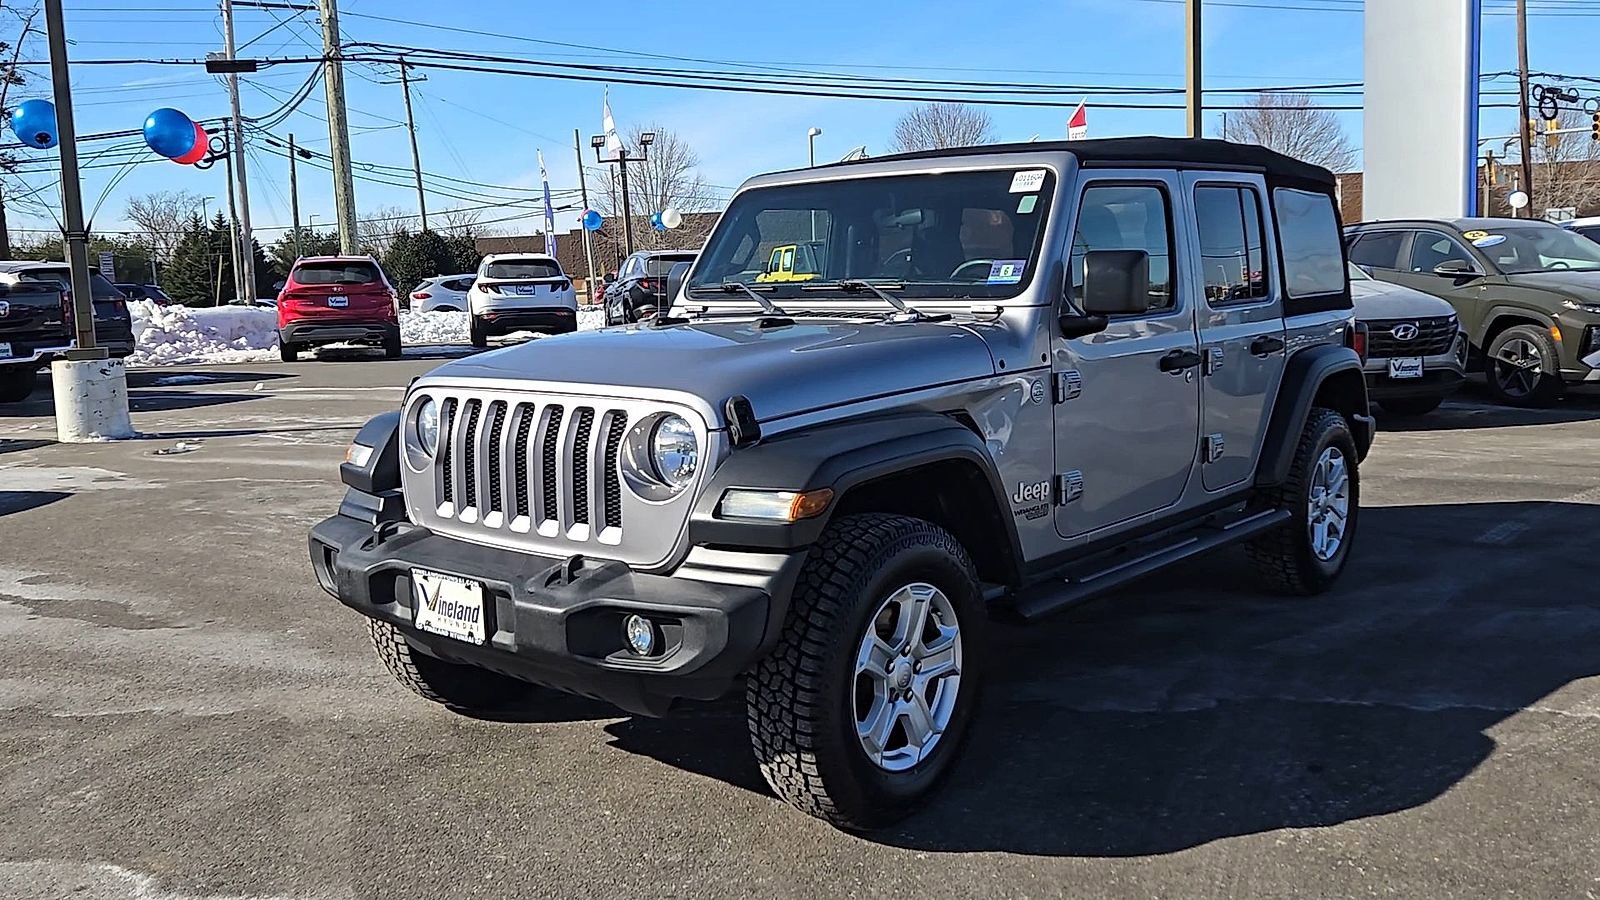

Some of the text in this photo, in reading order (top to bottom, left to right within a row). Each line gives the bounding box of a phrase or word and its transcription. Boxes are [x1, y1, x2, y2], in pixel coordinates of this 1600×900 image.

[1012, 480, 1050, 503] Jeep
[419, 580, 481, 624] Vineland
[437, 617, 480, 633] HYUNDAI
